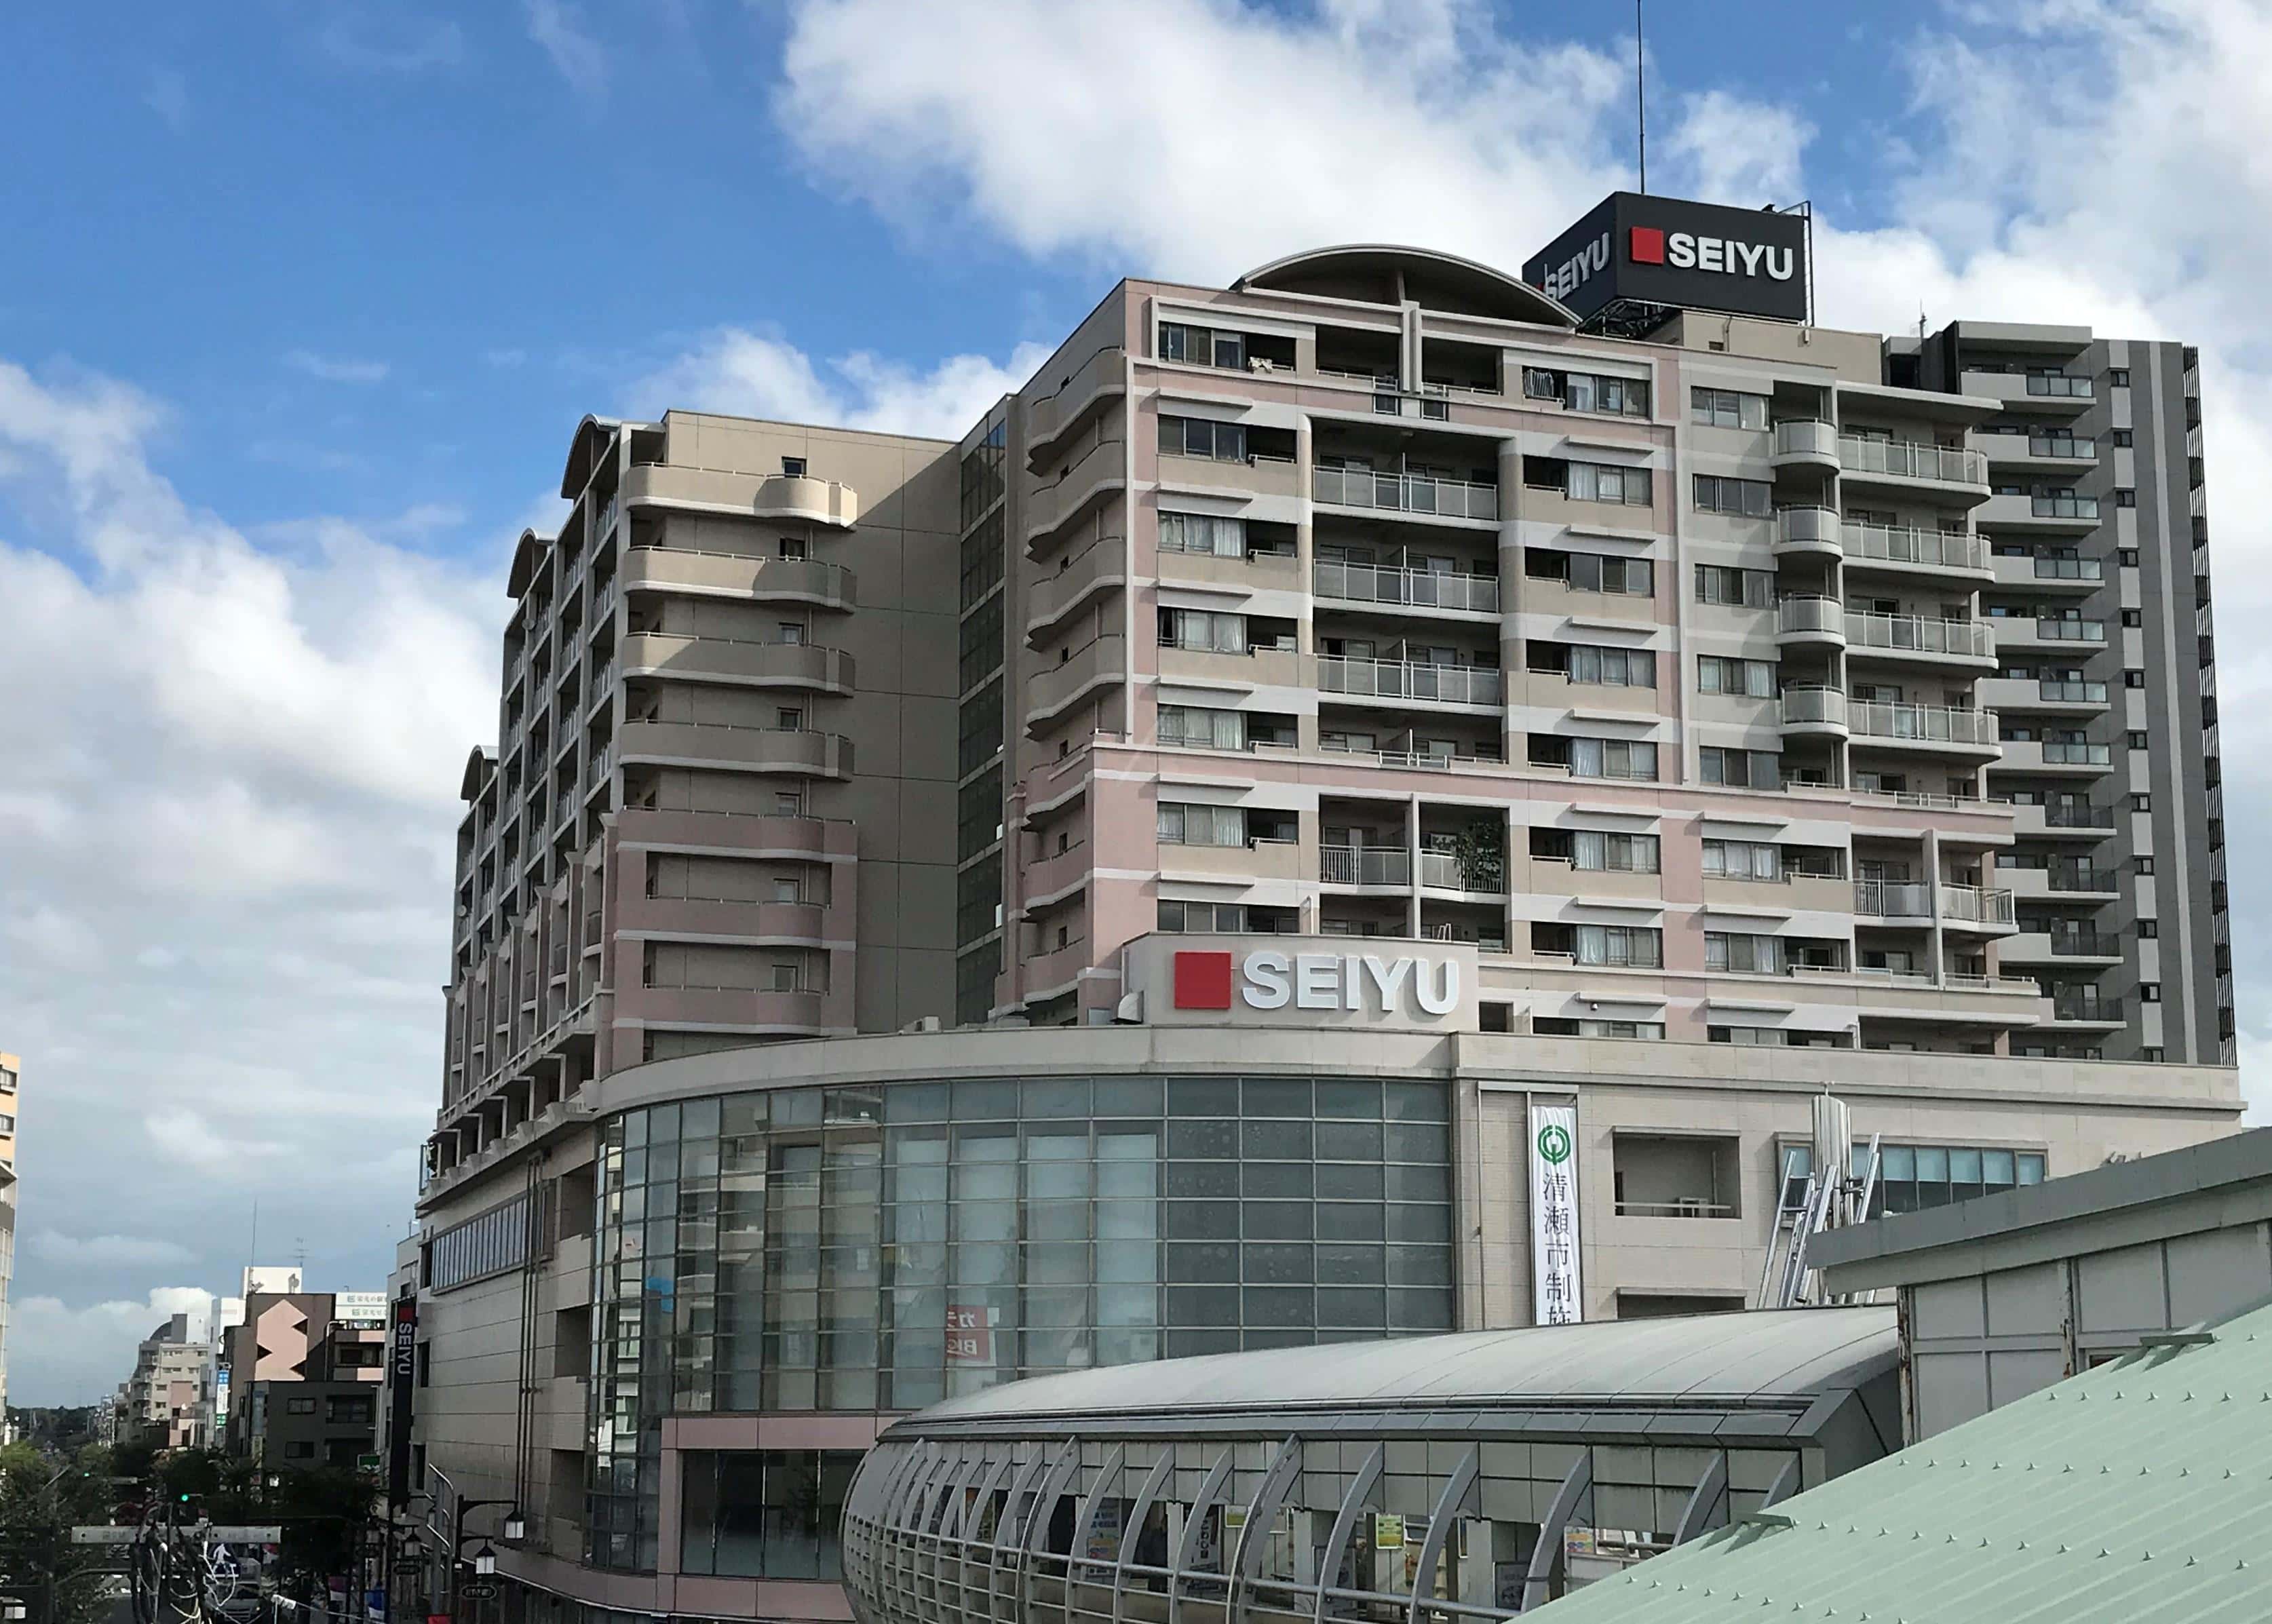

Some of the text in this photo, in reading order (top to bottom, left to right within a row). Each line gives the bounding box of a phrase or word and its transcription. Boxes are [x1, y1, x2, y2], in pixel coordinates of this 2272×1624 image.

[1668, 232, 1794, 281] SEIYU
[1242, 951, 1459, 1015] SEIYU
[397, 1322, 412, 1375] SEIYU
